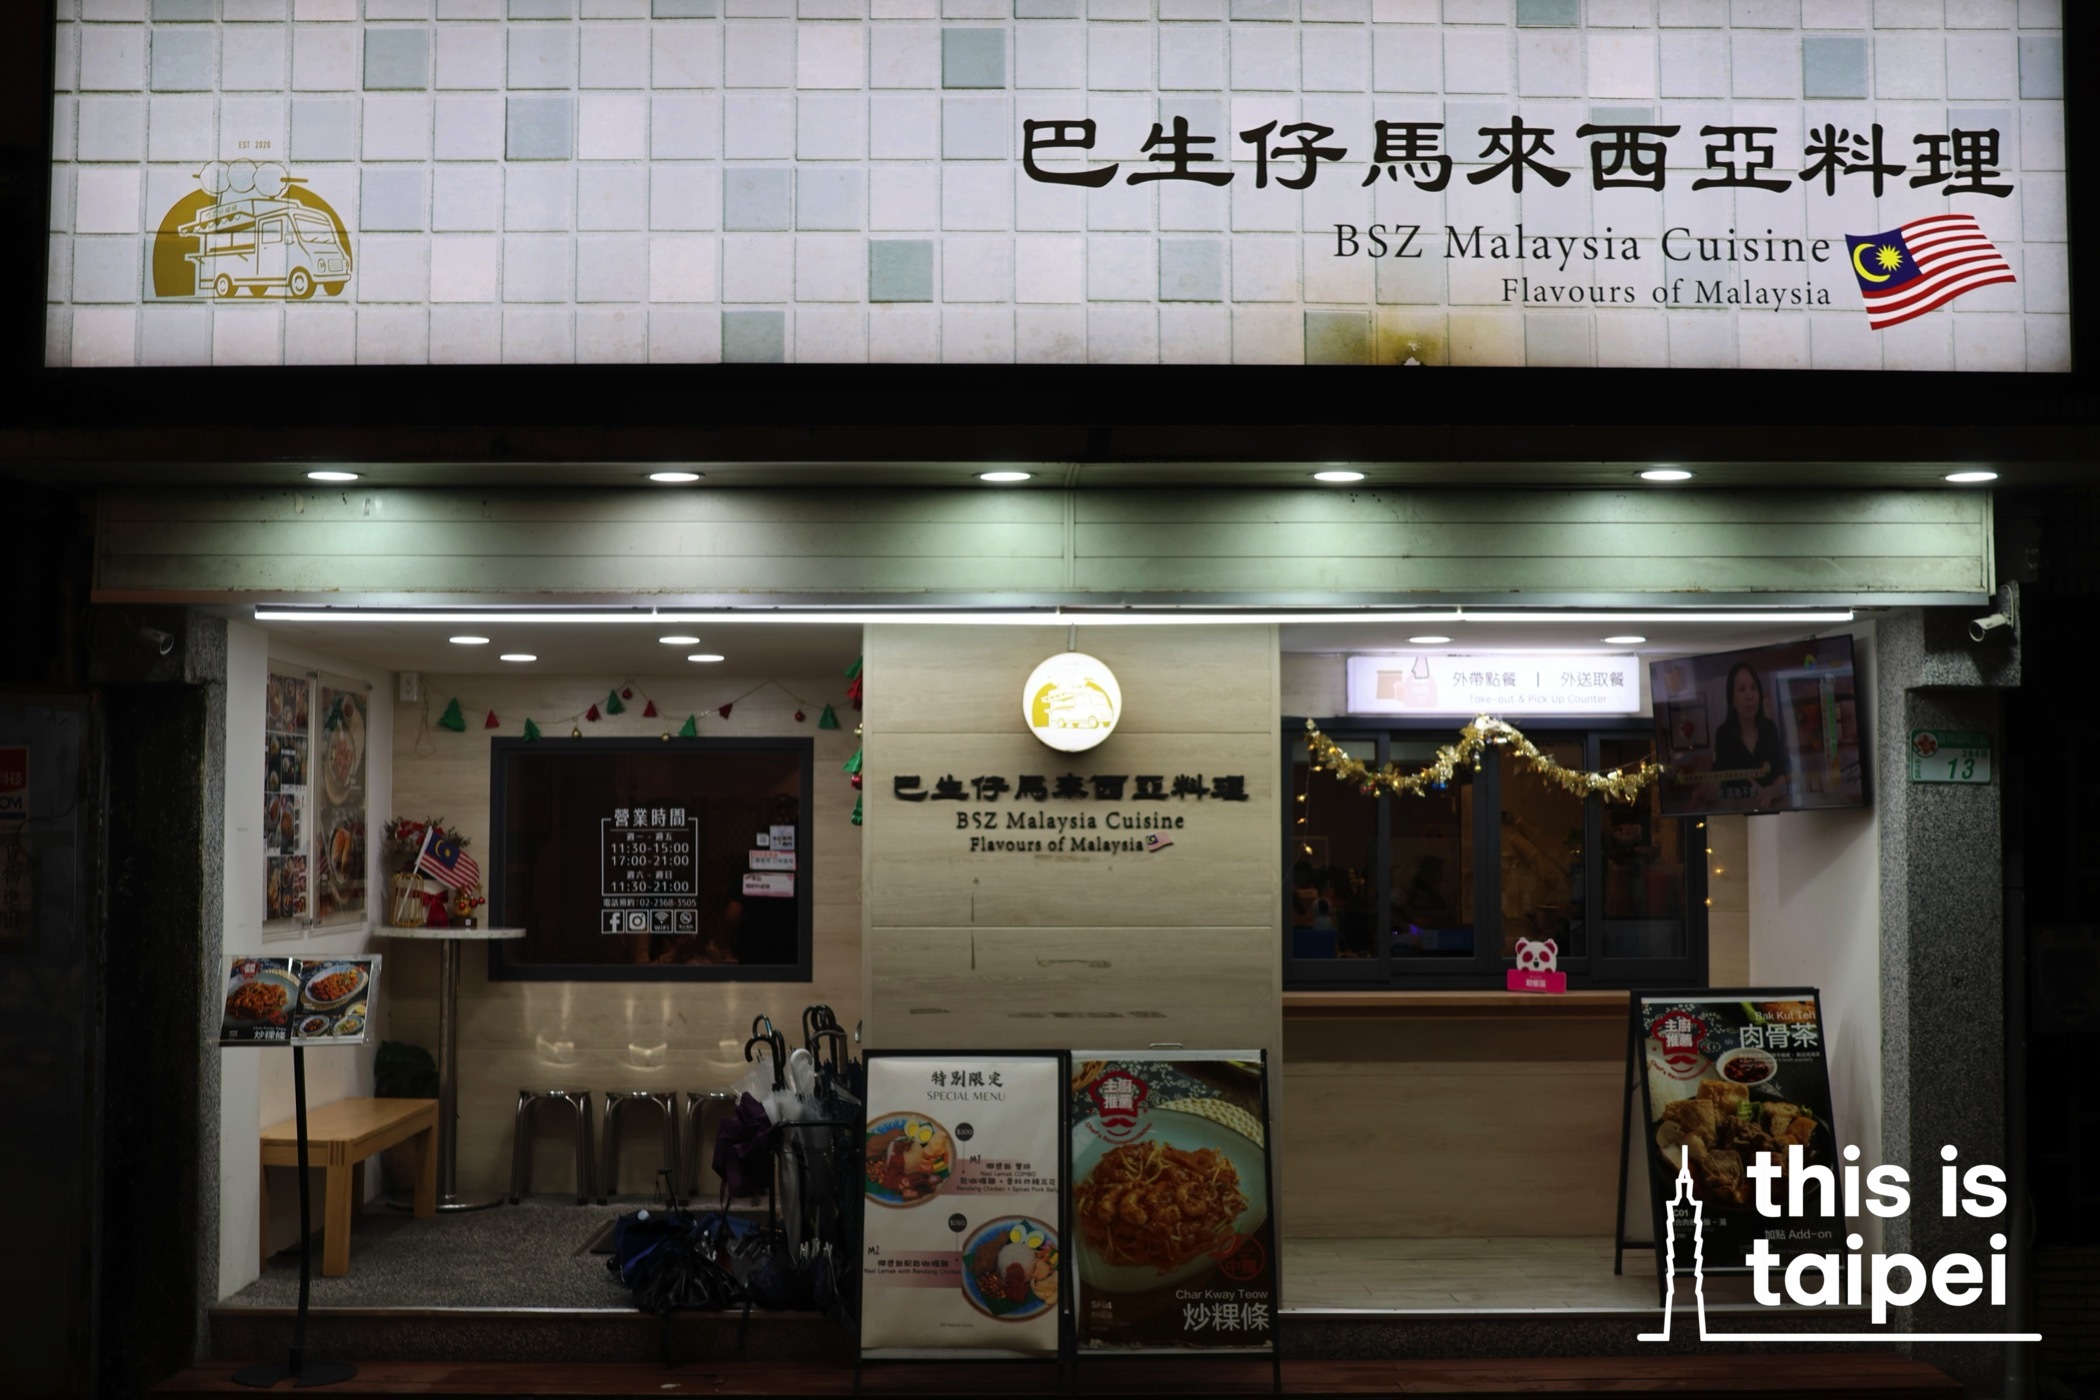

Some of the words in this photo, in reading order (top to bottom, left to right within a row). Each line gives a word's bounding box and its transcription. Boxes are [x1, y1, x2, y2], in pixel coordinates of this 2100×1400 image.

[238, 141, 250, 149] EST
[1022, 115, 2013, 198] 巴生仔馬來西亞料理
[1334, 223, 1424, 259] BSZ
[1445, 223, 1641, 272] Malaysia
[1661, 223, 1831, 264] Cuisine
[1501, 276, 1636, 304] Flavours
[1652, 276, 1682, 304] of
[1695, 278, 1831, 314] Malaysia
[1453, 671, 1516, 688] 外帶點餐
[1560, 671, 1624, 688] 外送取餐
[1469, 694, 1515, 704] Take-out
[1519, 694, 1525, 704] &
[1528, 694, 1548, 704] Pick
[1551, 694, 1564, 706] Up
[1567, 694, 1607, 704] Counter
[1947, 757, 1975, 780] 13
[893, 773, 1249, 802] 巴生仔馬來西亞料理
[614, 808, 685, 828] 營業時間
[956, 811, 998, 830] BSZ
[1006, 812, 1097, 834] Malaysia
[1105, 812, 1185, 830] Cuisine
[611, 842, 689, 854] 11:30-15:00
[969, 837, 1042, 852] Flavours
[1047, 837, 1065, 852] of
[1070, 837, 1144, 855] Malaysia
[611, 855, 689, 866] 17:00-21:00
[611, 881, 689, 892] 11:30-21:00
[1755, 1010, 1774, 1021] Bak
[1776, 1010, 1794, 1021] Kut
[1798, 1010, 1816, 1020] Teh
[1739, 1022, 1818, 1049] 肉骨茶
[931, 1070, 1004, 1088] 特別限定
[1103, 1078, 1133, 1094] 主廚
[926, 1091, 970, 1102] SPECIAL
[973, 1091, 1006, 1102] MENU
[1788, 1229, 1832, 1240] Add-on
[1175, 1289, 1202, 1300] Char
[1204, 1289, 1235, 1301] Kway
[1237, 1289, 1269, 1299] Teow
[1182, 1302, 1270, 1332] 炒粿條
